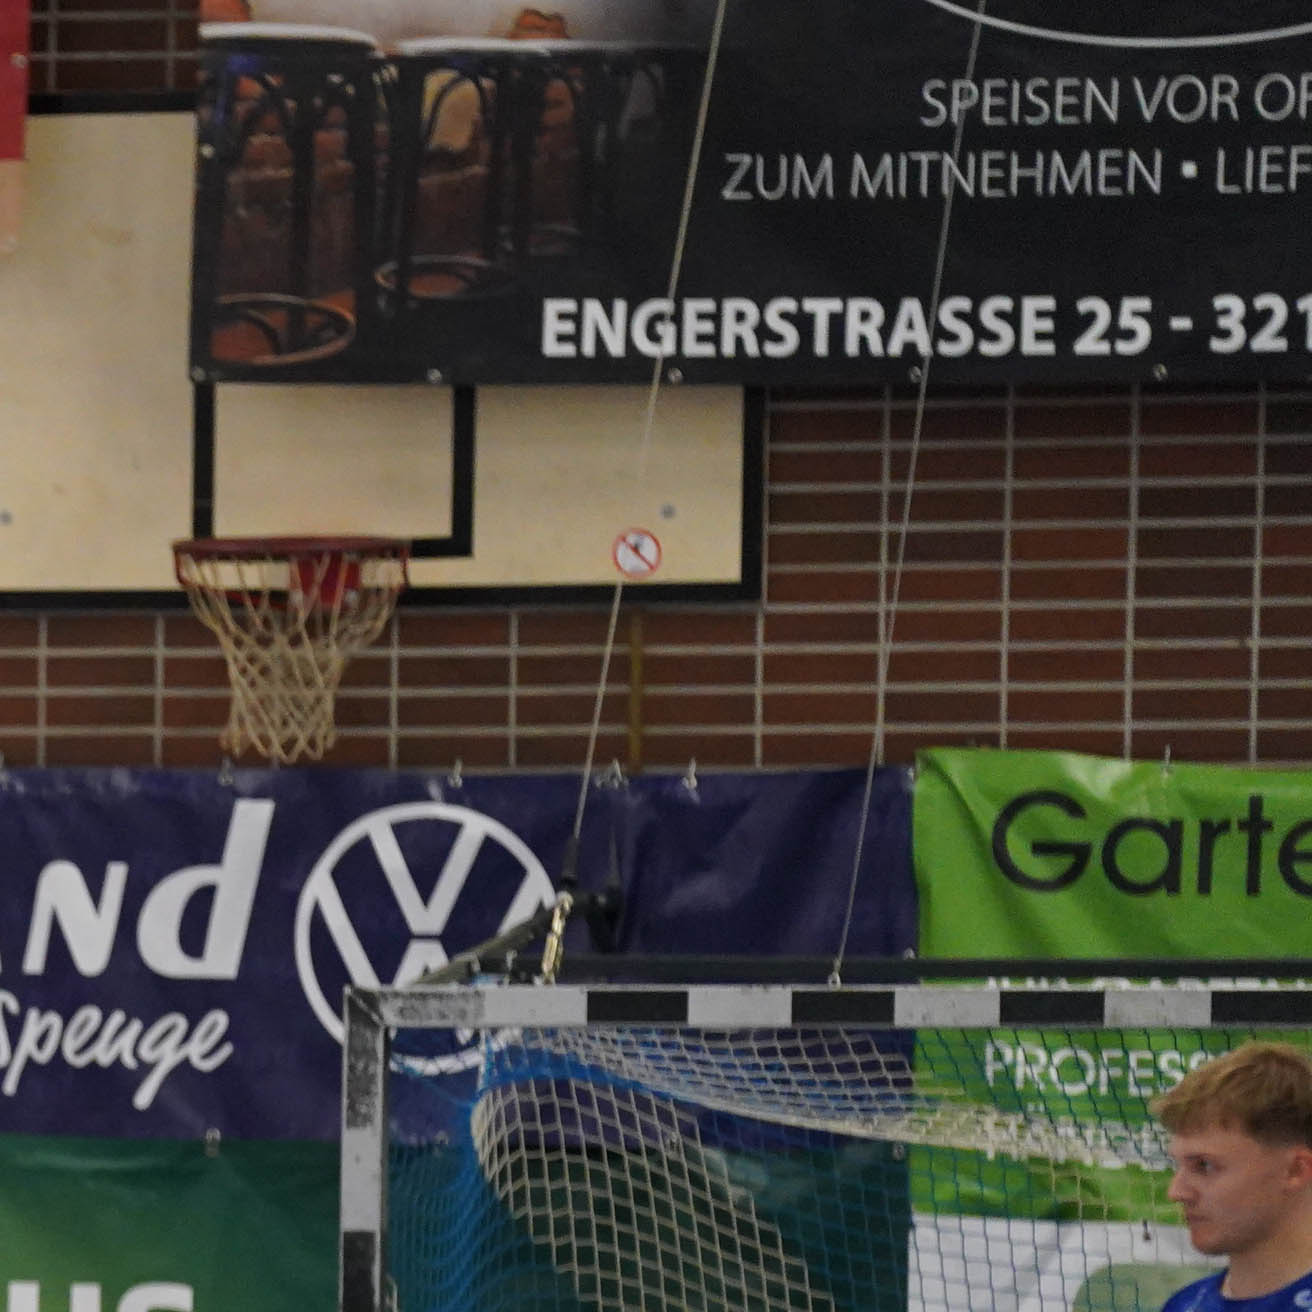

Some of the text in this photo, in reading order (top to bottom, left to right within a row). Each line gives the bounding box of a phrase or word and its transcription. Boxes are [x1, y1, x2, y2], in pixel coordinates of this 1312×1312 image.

[919, 76, 1120, 127] SPEISEN
[1132, 73, 1241, 123] VOR
[721, 153, 835, 201] ZUM
[849, 148, 1163, 199] MITNEHMEN
[541, 296, 1057, 359] ENGERSTRASSE
[1072, 296, 1154, 356] 25
